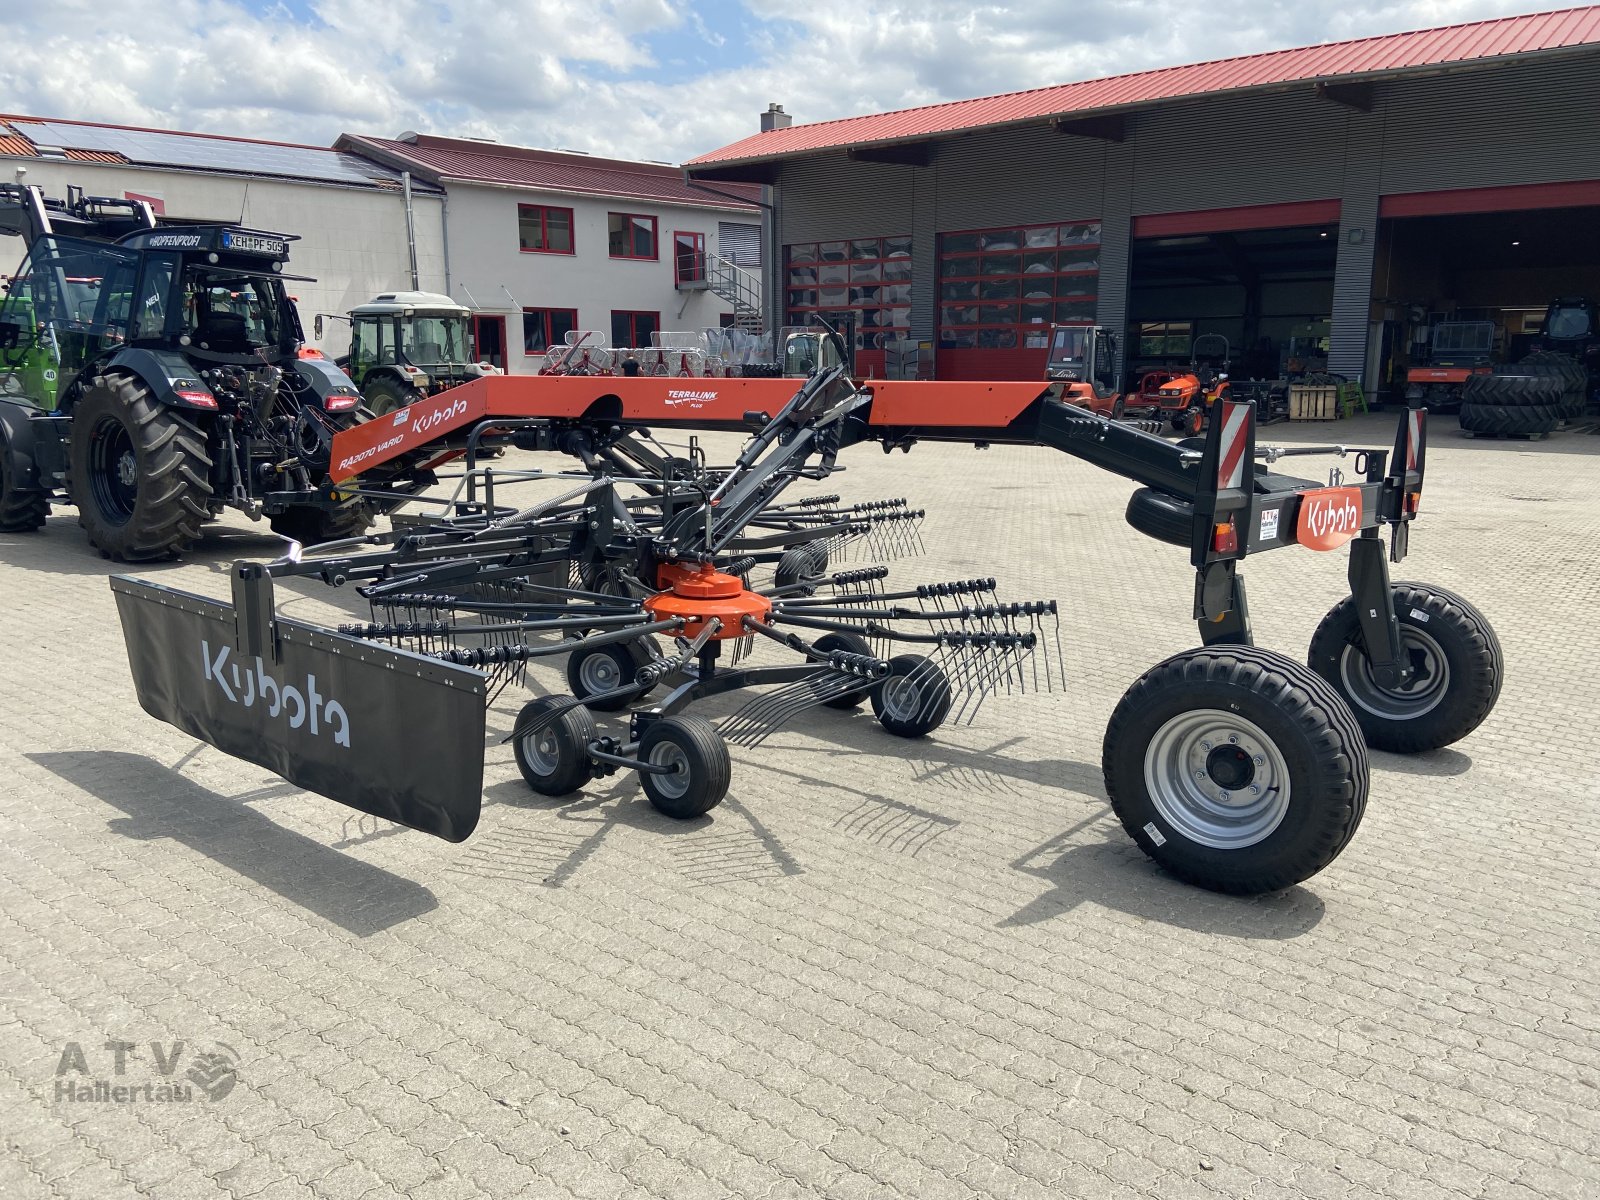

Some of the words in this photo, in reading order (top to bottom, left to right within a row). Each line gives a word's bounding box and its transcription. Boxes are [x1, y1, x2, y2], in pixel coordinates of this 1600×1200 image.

[230, 235, 248, 248] KEH
[253, 238, 265, 250] PF
[266, 240, 283, 252] 505
[145, 292, 160, 308] NEU
[45, 370, 55, 379] 40
[1051, 369, 1078, 378] Linde
[668, 390, 719, 400] TERRALINK
[411, 399, 467, 433] Kubota
[338, 446, 376, 471] RA2070
[377, 434, 404, 453] VARIO
[1307, 496, 1357, 537] Kubota
[201, 639, 351, 748] Kubota
